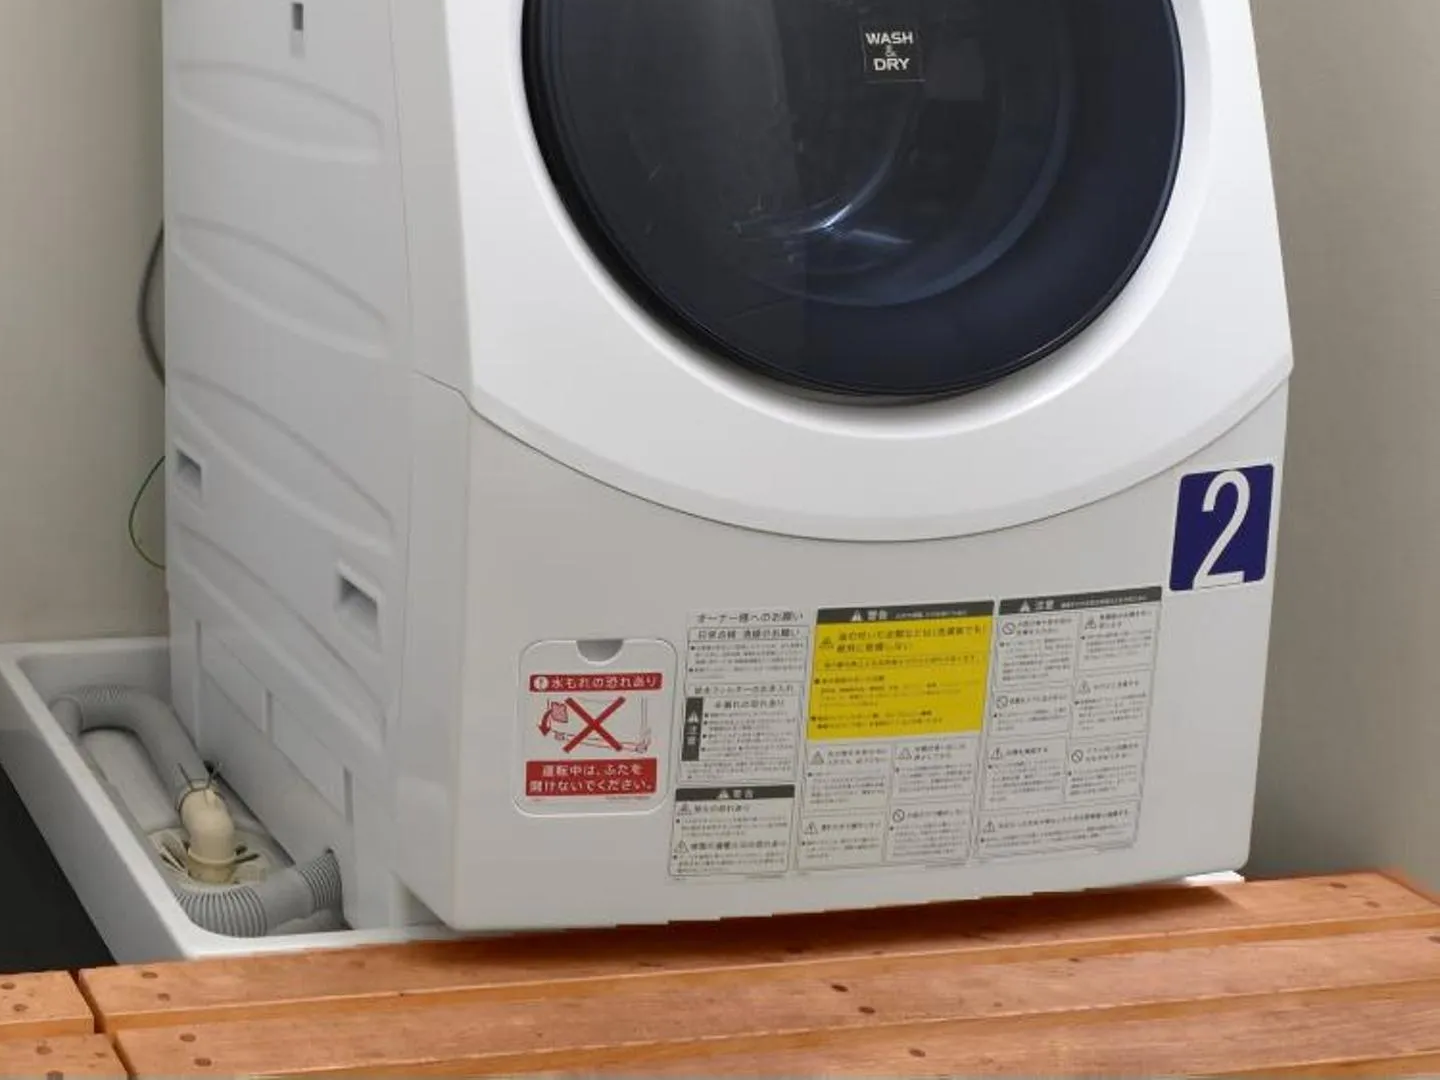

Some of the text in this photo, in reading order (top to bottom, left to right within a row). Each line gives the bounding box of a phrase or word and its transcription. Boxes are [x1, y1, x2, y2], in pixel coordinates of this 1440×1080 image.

[865, 31, 914, 44] WASH
[873, 58, 910, 71] DRY
[1192, 470, 1250, 590] 2
[551, 675, 658, 690] 水もれの恐れあり
